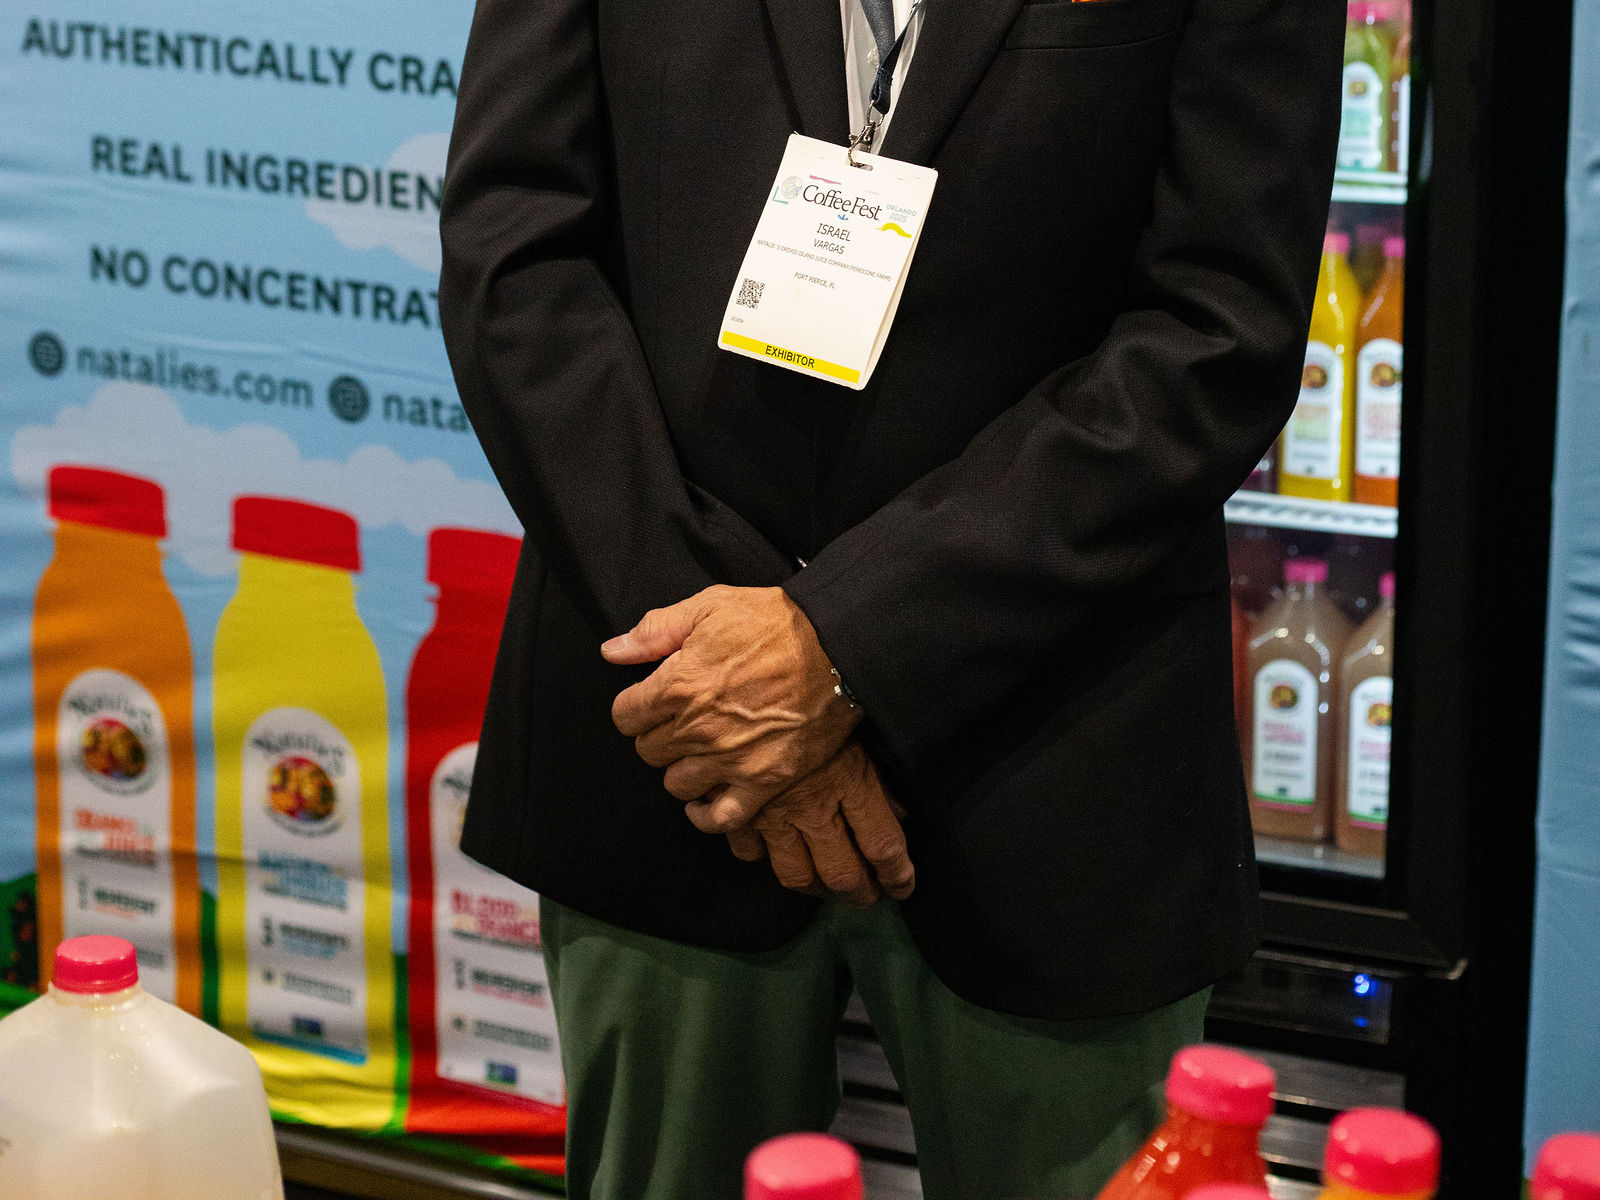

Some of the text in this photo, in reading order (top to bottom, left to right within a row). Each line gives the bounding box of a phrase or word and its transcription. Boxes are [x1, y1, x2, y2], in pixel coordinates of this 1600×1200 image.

[22, 18, 458, 97] AUTHENTICALLY CRA
[91, 134, 443, 211] REAL INGREDIEN
[886, 204, 917, 217] ORLANDO
[816, 222, 851, 242] ISRAEL
[813, 238, 846, 255] VARGAS
[89, 245, 150, 288] NO
[794, 271, 809, 281] FORT
[765, 345, 815, 369] EXHIBITOR
[76, 344, 314, 408] natalies.com
